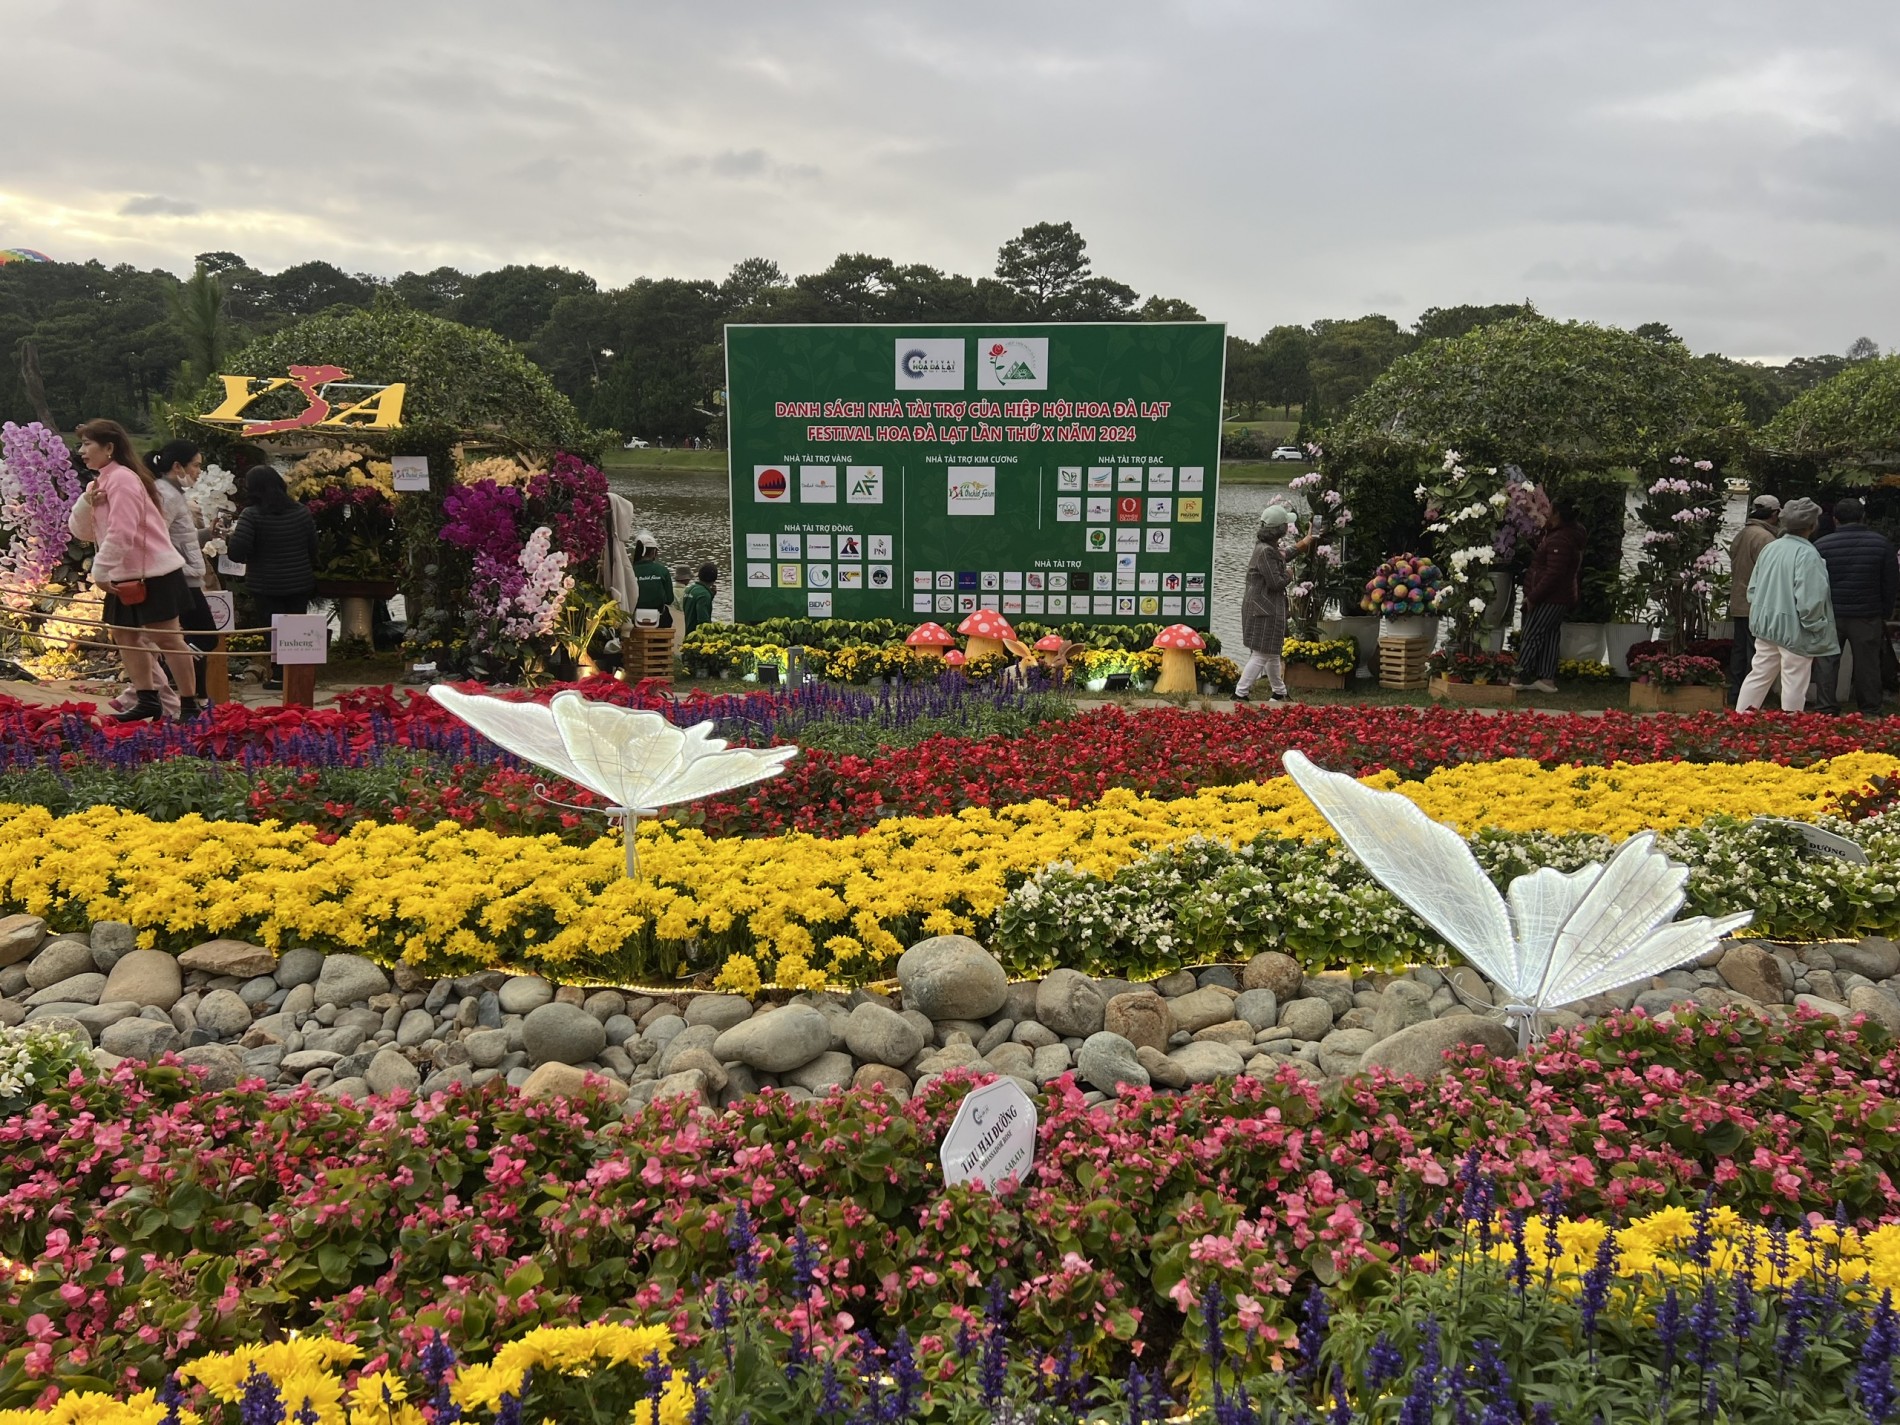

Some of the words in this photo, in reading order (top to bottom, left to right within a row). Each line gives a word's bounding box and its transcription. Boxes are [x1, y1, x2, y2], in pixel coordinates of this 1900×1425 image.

[776, 402, 820, 418] DANH
[824, 398, 864, 418] SÁCH
[868, 398, 904, 418] NHÀ
[906, 398, 932, 418] TÀI
[934, 401, 966, 421] TRỢ
[968, 398, 1001, 418] CỦA
[1004, 398, 1040, 421] HIỆP
[1043, 398, 1072, 421] HỘI
[1076, 402, 1111, 418] HOA
[1114, 398, 1138, 418] ĐÀ
[1141, 402, 1171, 421] LẠT
[807, 426, 873, 441] FESTIVAL
[876, 426, 912, 441] HOA
[914, 422, 937, 441] ĐÀ
[940, 426, 968, 444] LẠT
[971, 422, 1002, 442] LẦN
[1006, 422, 1040, 442] THỨ
[1042, 426, 1054, 442] X
[1057, 422, 1096, 442] NĂM
[1098, 426, 1136, 442] 2024
[784, 454, 800, 462] NHÀ
[802, 454, 814, 462] TÀI
[816, 455, 830, 464] TRỢ
[831, 454, 852, 462] VÀNG
[926, 454, 942, 463] NHÀ
[944, 454, 956, 463] TÀI
[958, 456, 973, 464] TRỢ
[1098, 455, 1115, 464] NHÀ
[1117, 455, 1130, 464] TÀI
[1131, 456, 1146, 464] TRỢ
[1148, 456, 1164, 464] BẠC
[784, 523, 800, 531] NHÀ
[802, 524, 814, 532] TÀI
[816, 524, 830, 533] TRỢ
[832, 523, 853, 532] ĐỒNG
[1034, 558, 1051, 567] NHÀ
[1053, 559, 1066, 568] TÀI
[1067, 560, 1082, 569] TRỢ
[961, 1148, 980, 1174] THU
[992, 1104, 1018, 1139] ĐƯỜNG
[1005, 1148, 1025, 1174] SAKATA
